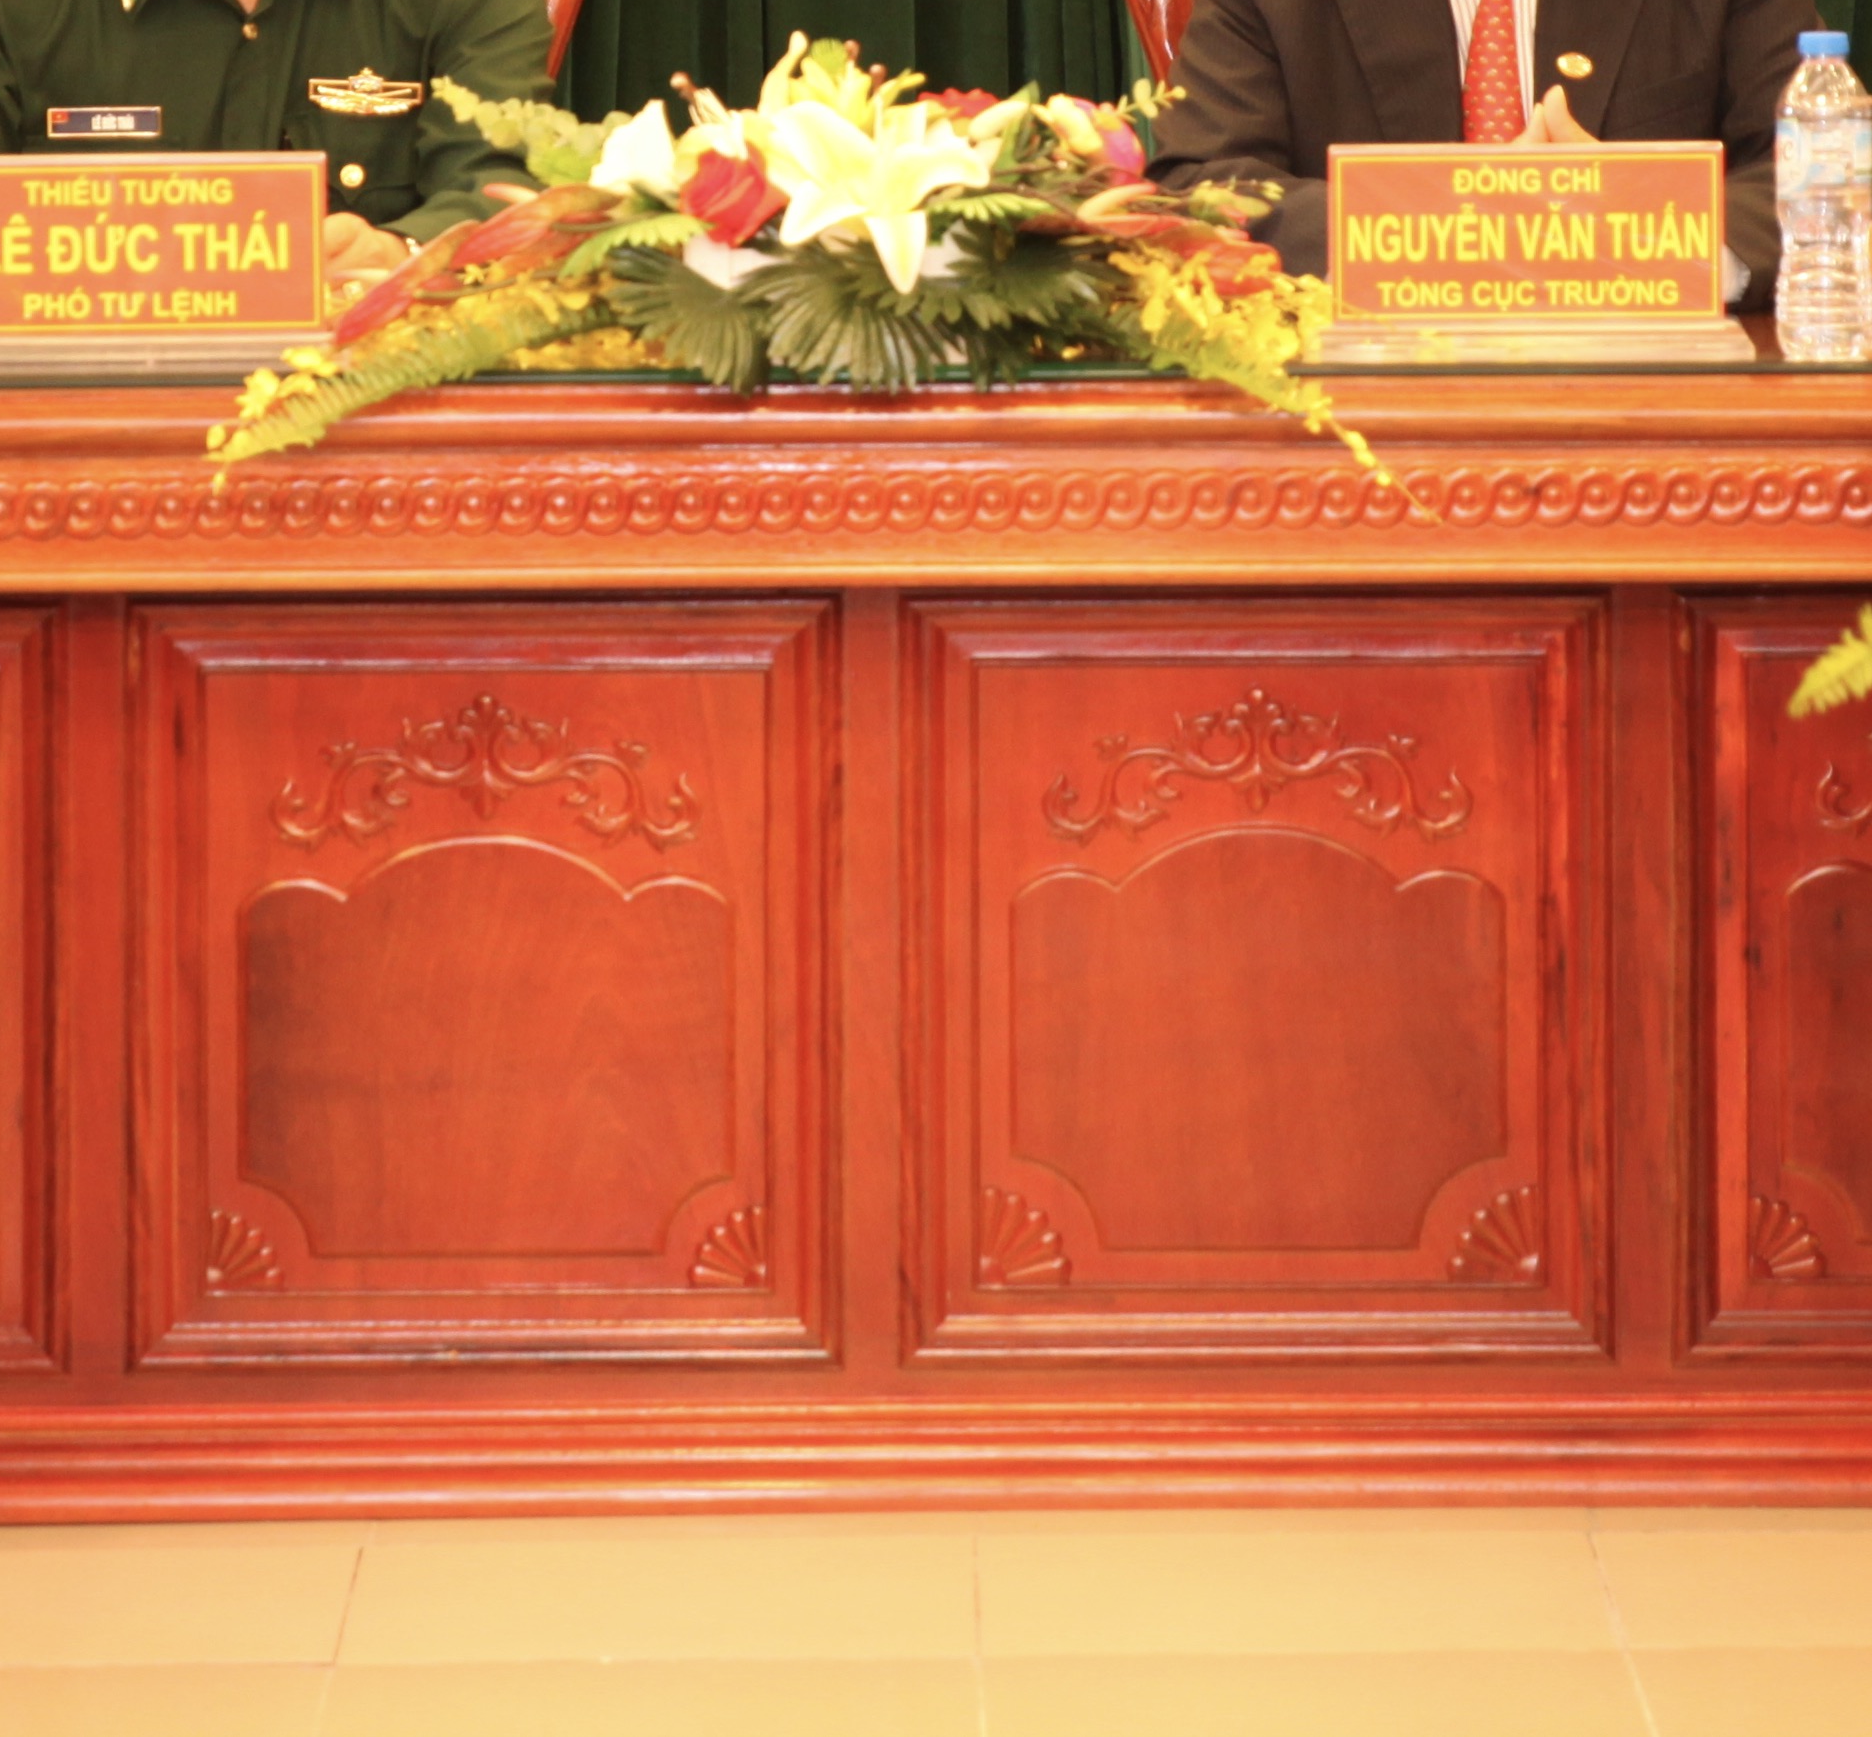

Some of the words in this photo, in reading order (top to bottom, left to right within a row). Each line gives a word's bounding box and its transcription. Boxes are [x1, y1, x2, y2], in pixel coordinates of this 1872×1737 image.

[47, 212, 160, 274] ĐỨC
[174, 210, 290, 272] THÁI
[1348, 204, 1506, 263] NGUYỄN
[1517, 202, 1596, 261] VĂN
[1607, 202, 1710, 261] TUẤN
[24, 288, 92, 320] PHÓ
[100, 293, 147, 318] TƯ
[153, 290, 238, 323] LỆNH
